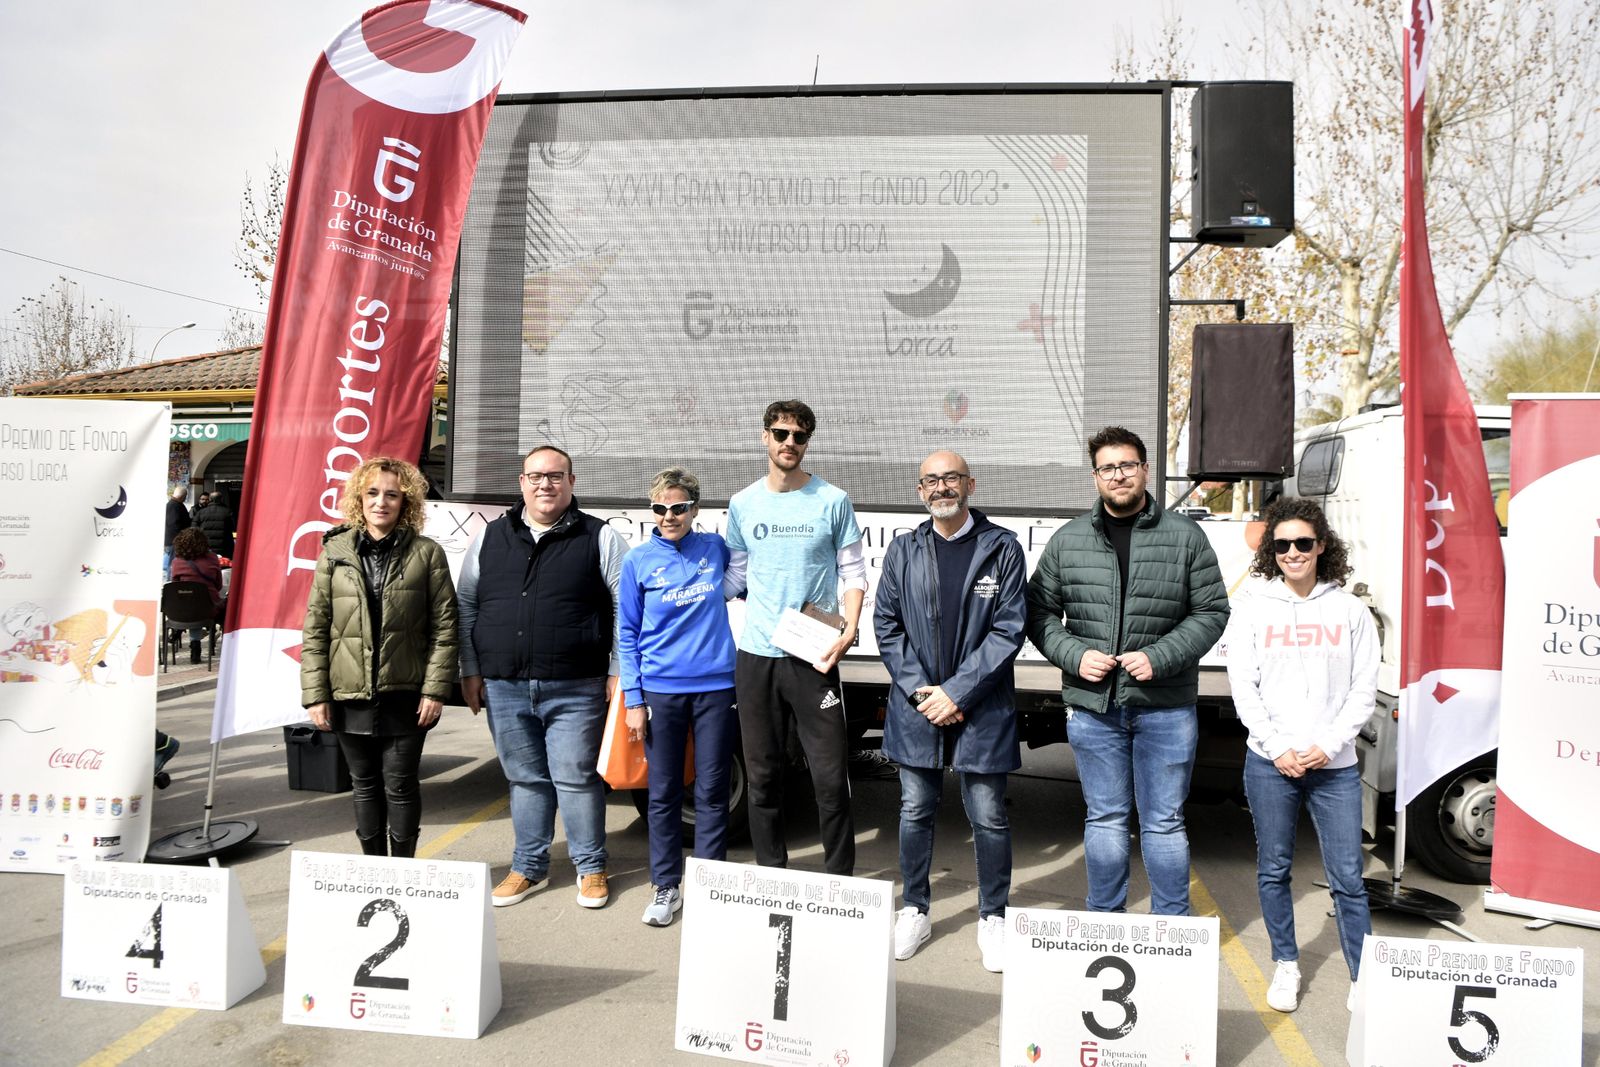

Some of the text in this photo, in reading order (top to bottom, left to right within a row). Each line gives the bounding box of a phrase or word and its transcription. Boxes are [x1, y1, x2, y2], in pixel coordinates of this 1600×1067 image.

[674, 172, 726, 207] GRAN
[738, 172, 812, 206] PREMIO
[824, 177, 848, 206] DE
[860, 170, 927, 206] FONDO
[938, 169, 999, 205] 2023
[332, 190, 437, 242] Diputación
[328, 213, 433, 262] de Granada
[706, 217, 888, 253] UNIVERSO LORCA
[327, 240, 389, 266] Avanzamos
[720, 303, 799, 319] Diputación
[719, 321, 799, 335] de Granada
[2, 423, 128, 452] PREMIO DE FONDO
[286, 295, 390, 576] Deportes
[1, 459, 68, 481] RSO LORCA
[662, 584, 715, 603] MARACENA
[675, 595, 706, 607] Granada
[1543, 632, 1573, 655] de
[820, 698, 840, 709] adidas
[302, 856, 475, 888] GRAN PREMIO DE FONDO
[83, 886, 208, 904] Diputación de Granada
[314, 880, 459, 900] Diputación de Granada
[695, 864, 882, 908] GRAN PREMIO DE FONDO
[709, 889, 865, 920] Diputación de Granada
[125, 902, 164, 969] 4
[1015, 913, 1209, 944] GRAN PREMIO DE FONDO
[353, 898, 410, 990] 2
[1031, 938, 1192, 957] Diputación de Granada
[768, 913, 793, 1021] 1
[1375, 941, 1576, 976] GRAN PREMIO DE FONDO
[1391, 966, 1558, 989] Diputación de Granada
[369, 999, 411, 1011] Diputación
[1081, 955, 1138, 1041] 3
[378, 1010, 411, 1020] Granada
[1447, 984, 1500, 1063] 5
[766, 1031, 812, 1046] Diputación
[766, 1042, 812, 1057] de Granada
[1101, 1048, 1147, 1061] Diputación
